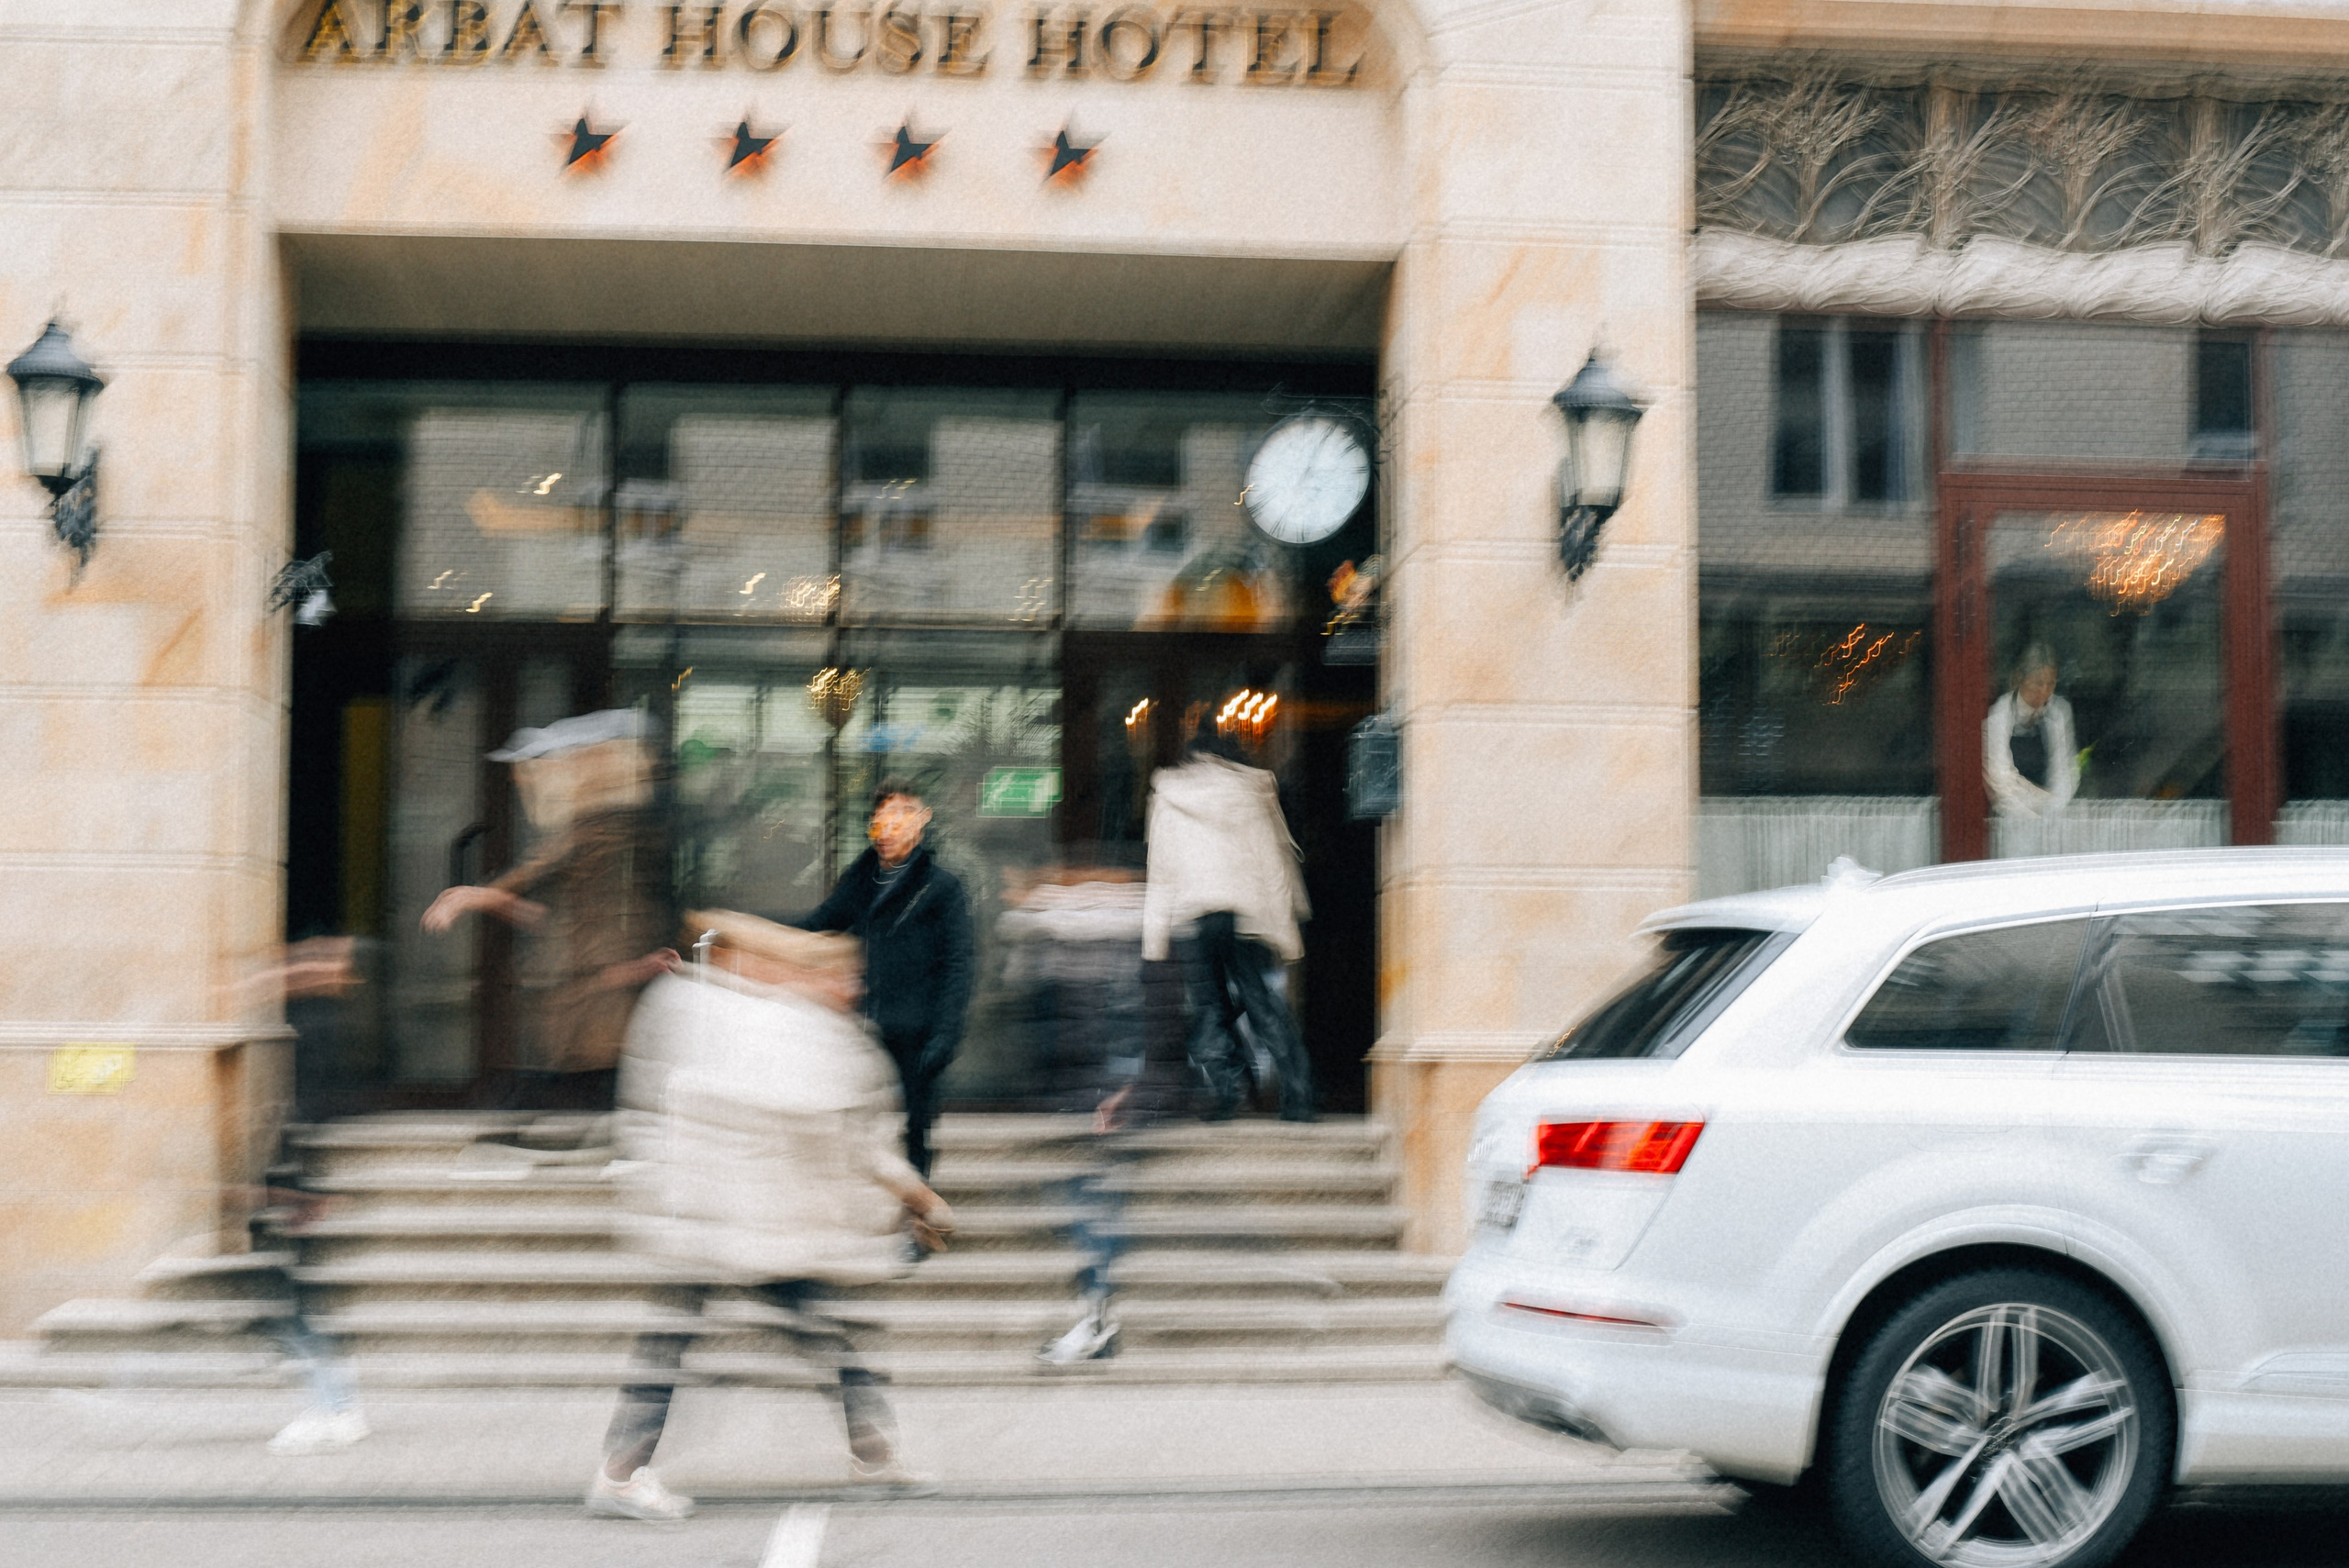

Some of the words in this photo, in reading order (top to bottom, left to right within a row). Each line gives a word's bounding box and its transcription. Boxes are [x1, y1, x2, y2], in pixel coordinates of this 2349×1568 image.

[297, 0, 622, 70] ARBAT
[657, 0, 994, 81] HOUSE
[1022, 4, 1369, 88] HOTEL
